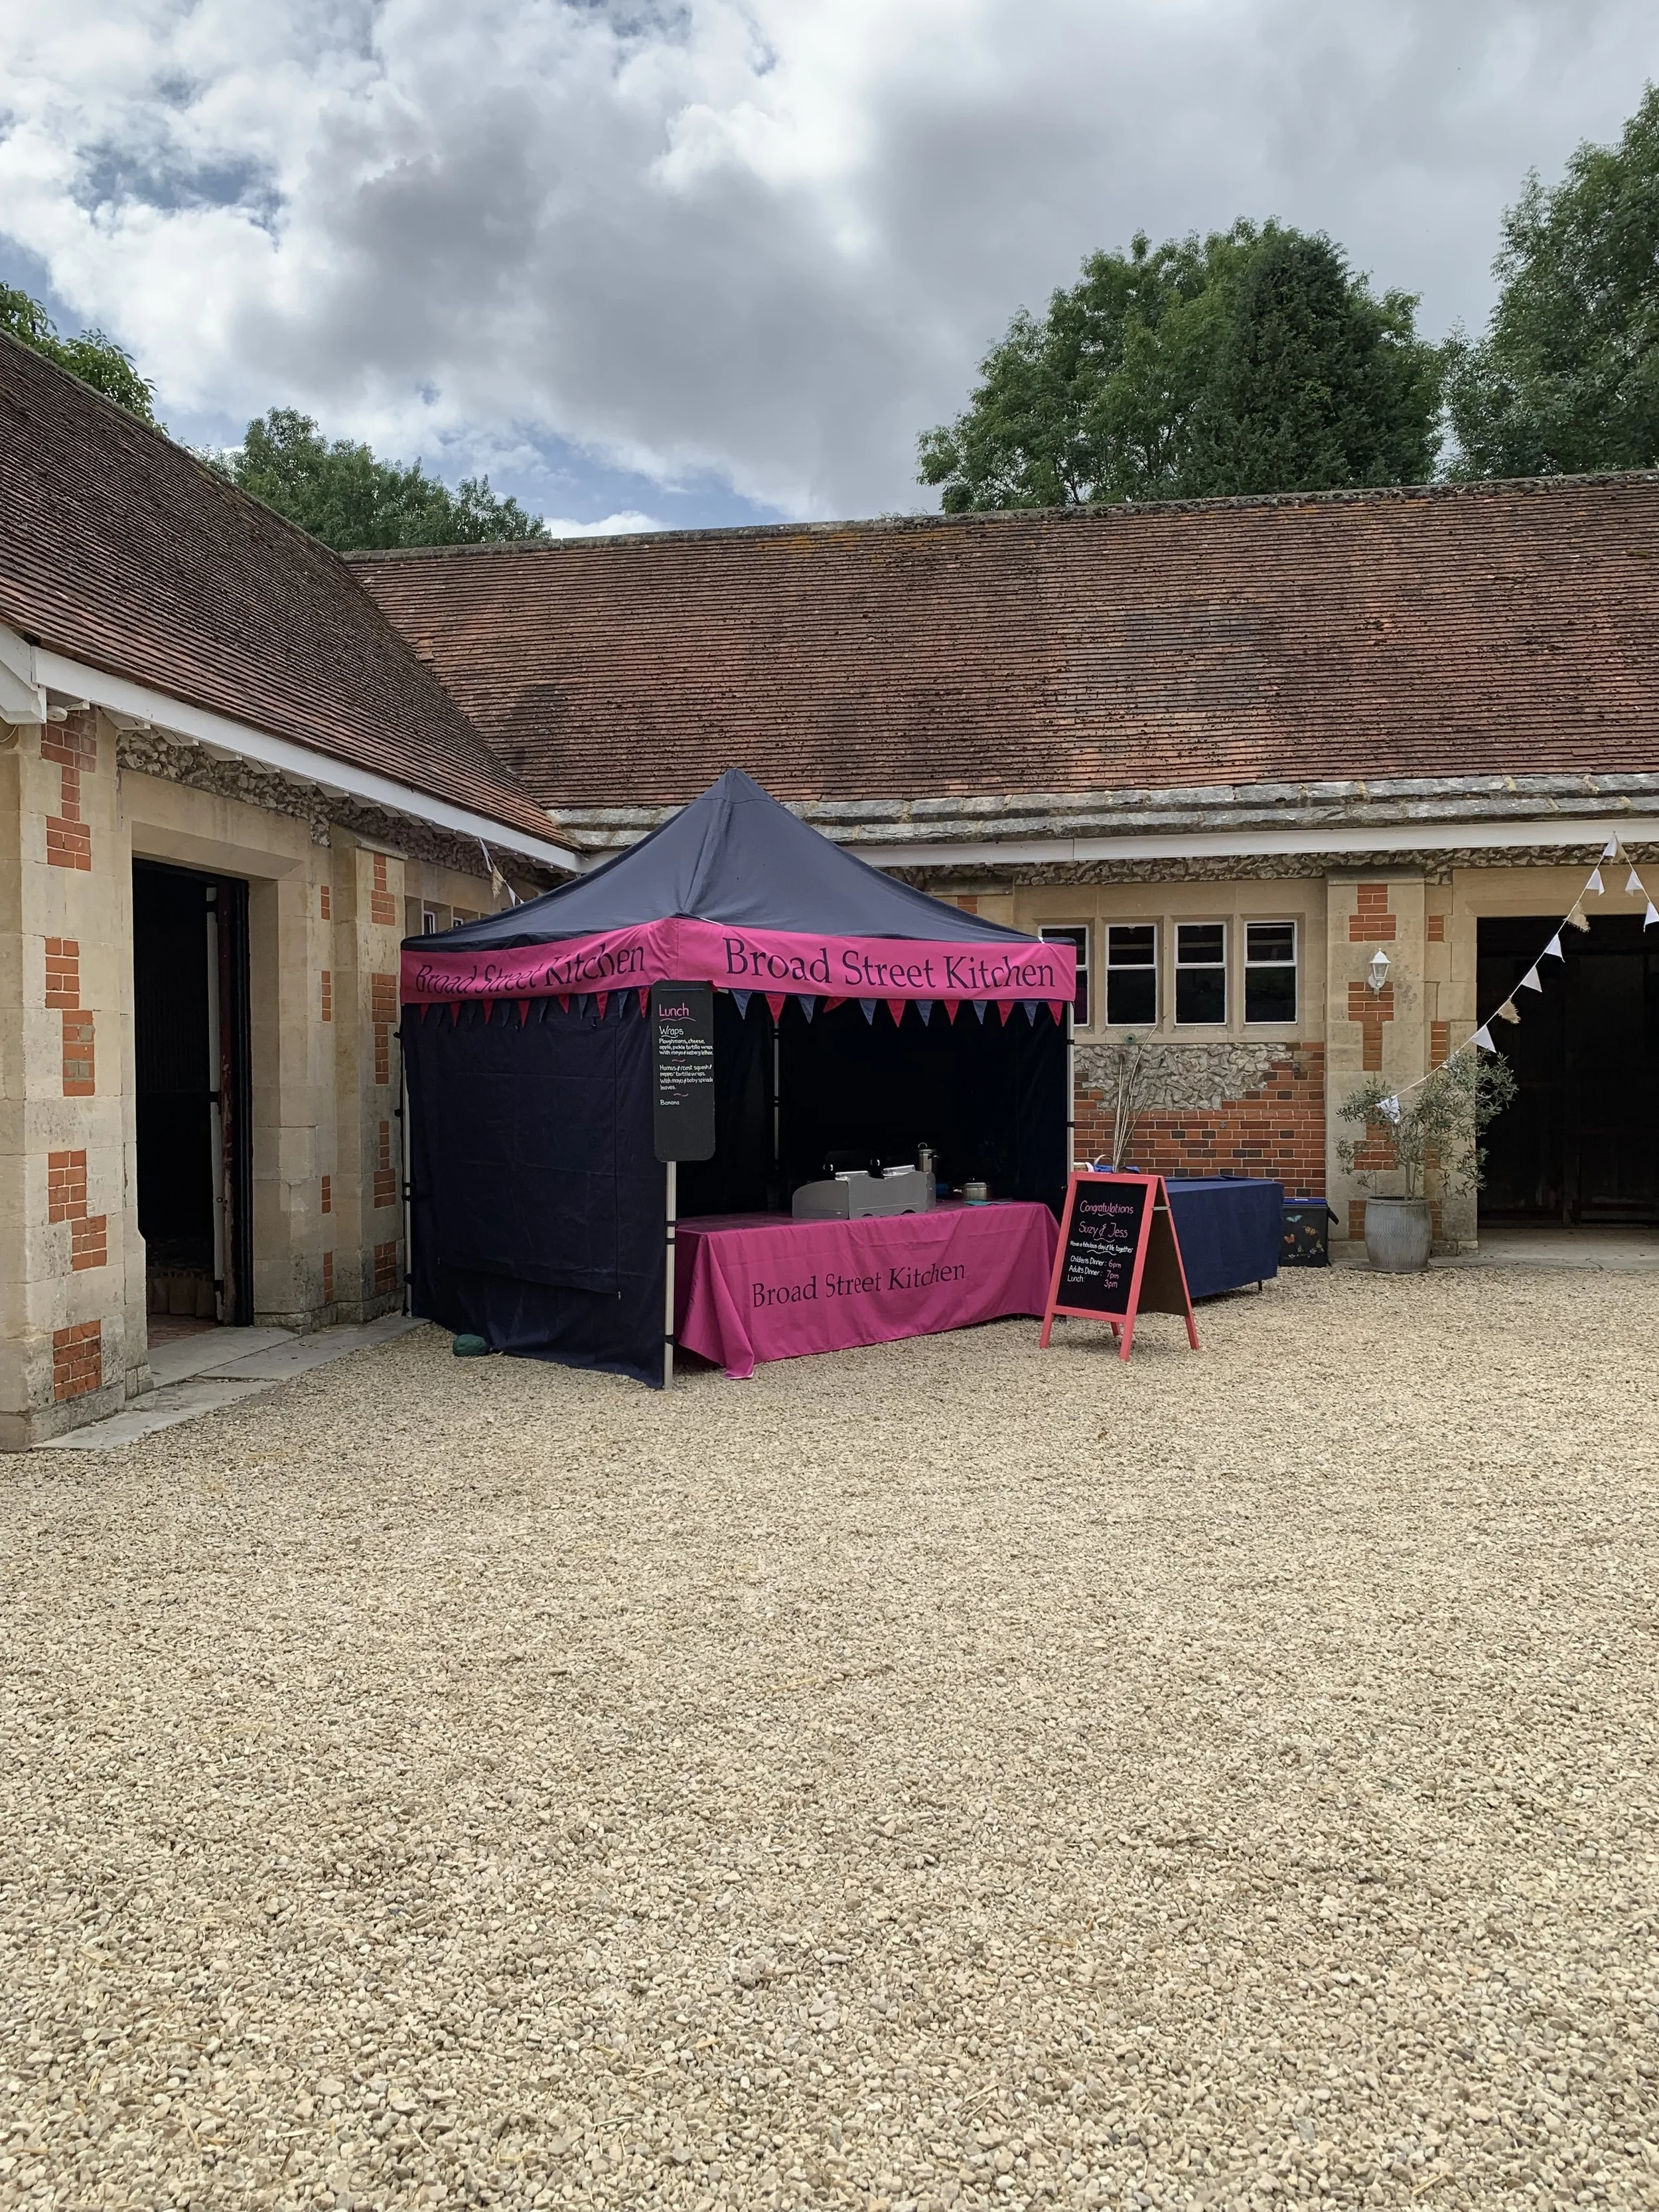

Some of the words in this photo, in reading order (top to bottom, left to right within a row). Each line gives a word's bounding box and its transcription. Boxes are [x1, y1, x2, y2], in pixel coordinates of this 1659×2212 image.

[416, 964, 477, 994] Broad
[474, 962, 543, 994] Street
[545, 943, 644, 987] Kitchen
[723, 937, 833, 984] Broad
[841, 950, 935, 988] Street
[943, 955, 1055, 989] Kitchen
[659, 1002, 689, 1017] Lunch
[658, 1025, 684, 1036] Wraps
[1080, 1200, 1134, 1215] Congratulations
[1078, 1220, 1099, 1237] Suzy
[1099, 1223, 1107, 1237] &
[1108, 1222, 1128, 1238] Jess
[1108, 1259, 1121, 1269] 6pm
[1106, 1270, 1119, 1280] 7pm
[751, 1276, 819, 1308] Broad
[826, 1272, 881, 1298] Street
[887, 1263, 966, 1290] Kitchen
[1104, 1279, 1118, 1289] 3pm
